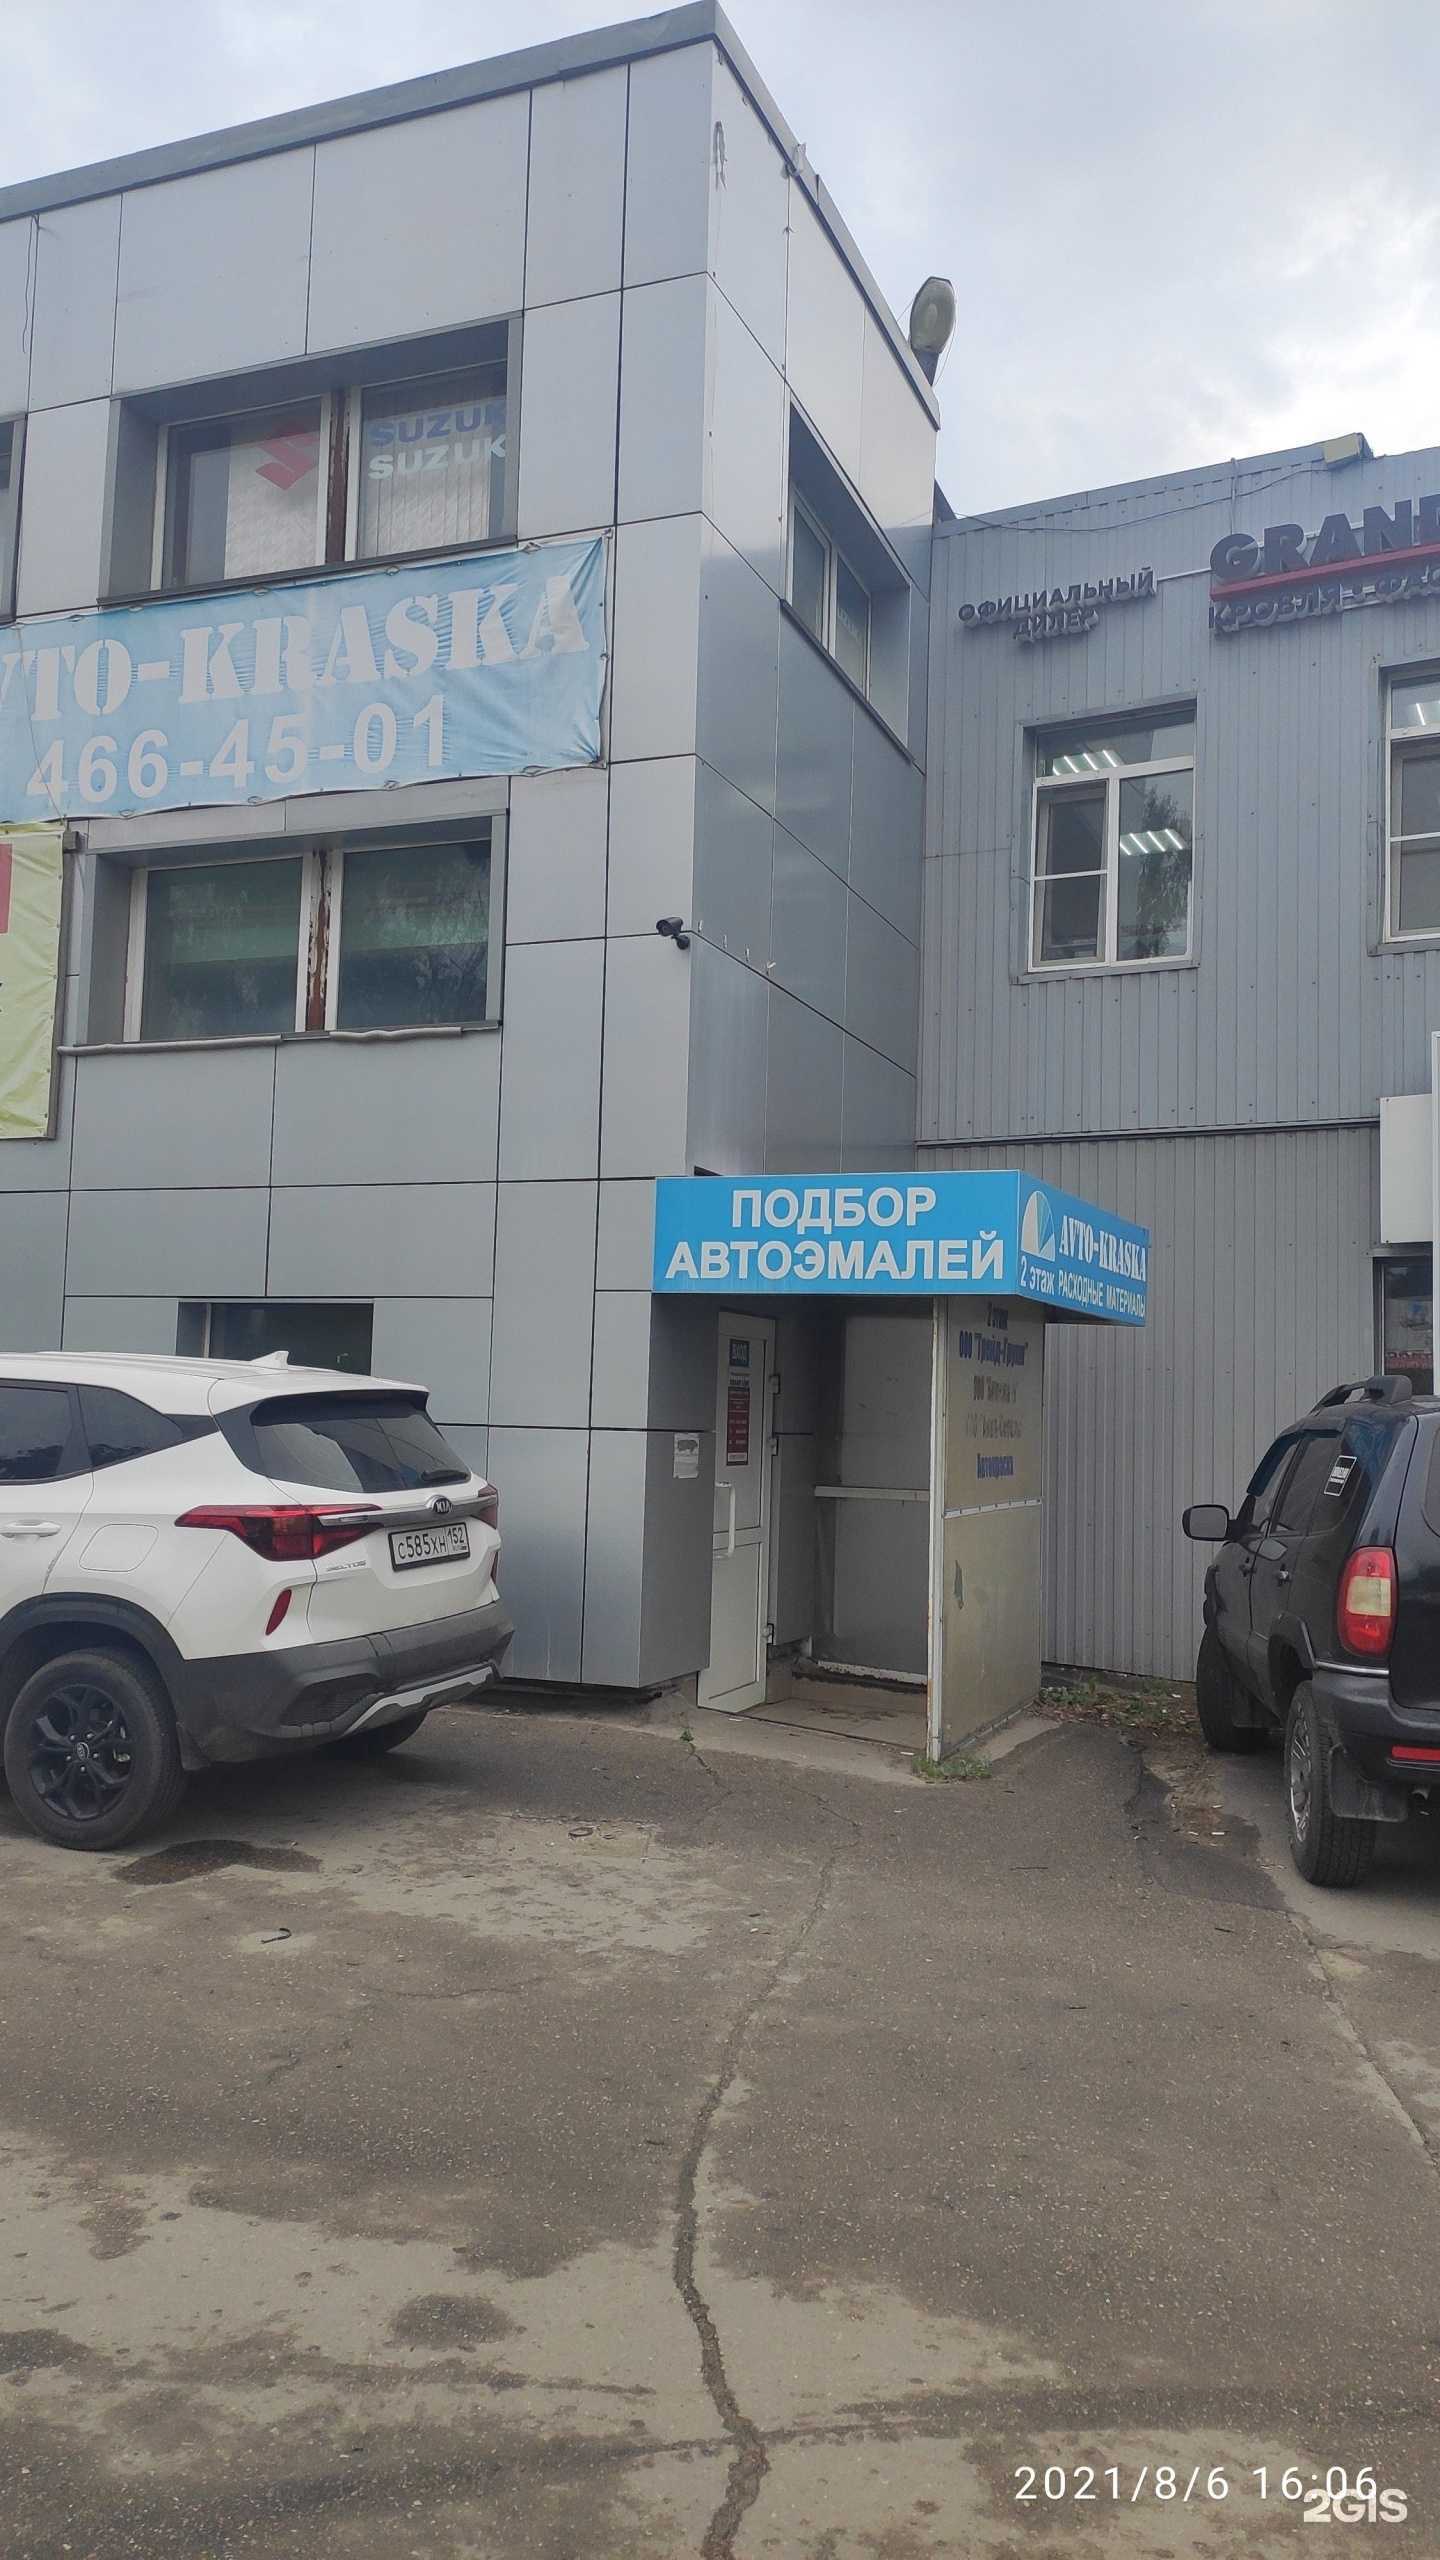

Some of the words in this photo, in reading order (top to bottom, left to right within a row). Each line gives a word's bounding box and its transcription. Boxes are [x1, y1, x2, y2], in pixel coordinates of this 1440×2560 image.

[958, 567, 1158, 626] ОФИЦИАЛЬНЫЙ
[1012, 606, 1099, 642] ДИЛЕР
[26, 694, 447, 803] 466-45-01
[731, 1187, 937, 1235] ПОДБОР
[664, 1230, 1004, 1280] АВТОЭМАЛЕЙ
[1059, 1215, 1147, 1282] AVTO-KRASKA
[1020, 1255, 1027, 1288] 2
[1058, 1269, 1104, 1308] РАСХОДНЫЕ
[1106, 1283, 1146, 1318] МАТЕРИАЛЫ
[435, 1500, 454, 1514] KIA
[447, 1526, 465, 1546] 152
